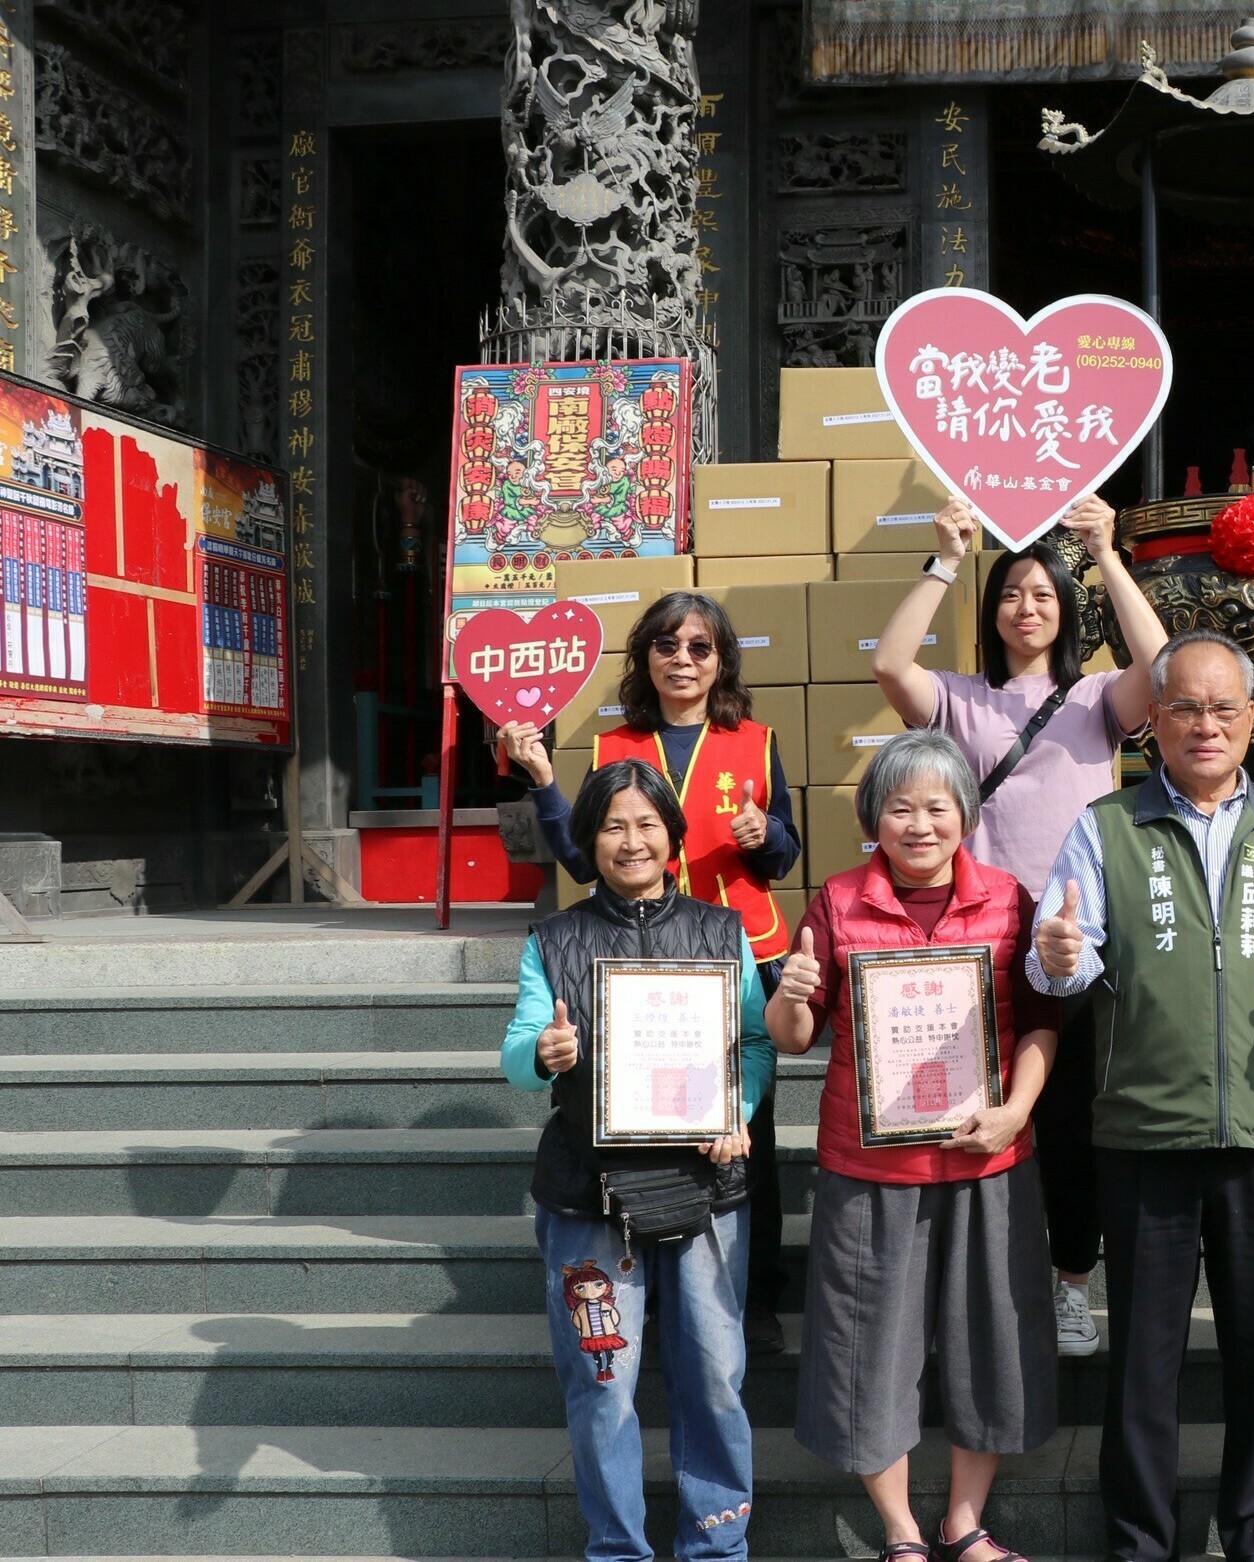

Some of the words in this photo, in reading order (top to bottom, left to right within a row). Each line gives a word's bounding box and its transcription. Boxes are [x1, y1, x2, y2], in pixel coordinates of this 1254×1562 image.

[1077, 335, 1136, 350] 愛心專線
[908, 341, 1070, 400] 當我變老
[1076, 355, 1162, 370] (06)252-0940
[548, 387, 590, 397] 四安境
[545, 396, 590, 490] 南廠保安宮
[935, 396, 1119, 470] 請你愛我
[985, 473, 1073, 492] 華山基金會
[470, 635, 586, 682] 中西站
[715, 771, 738, 815] 華山
[1151, 846, 1165, 872] 秘書
[1149, 877, 1177, 952] 陳明才
[646, 991, 689, 1007] 感謝
[901, 980, 944, 998] 感謝
